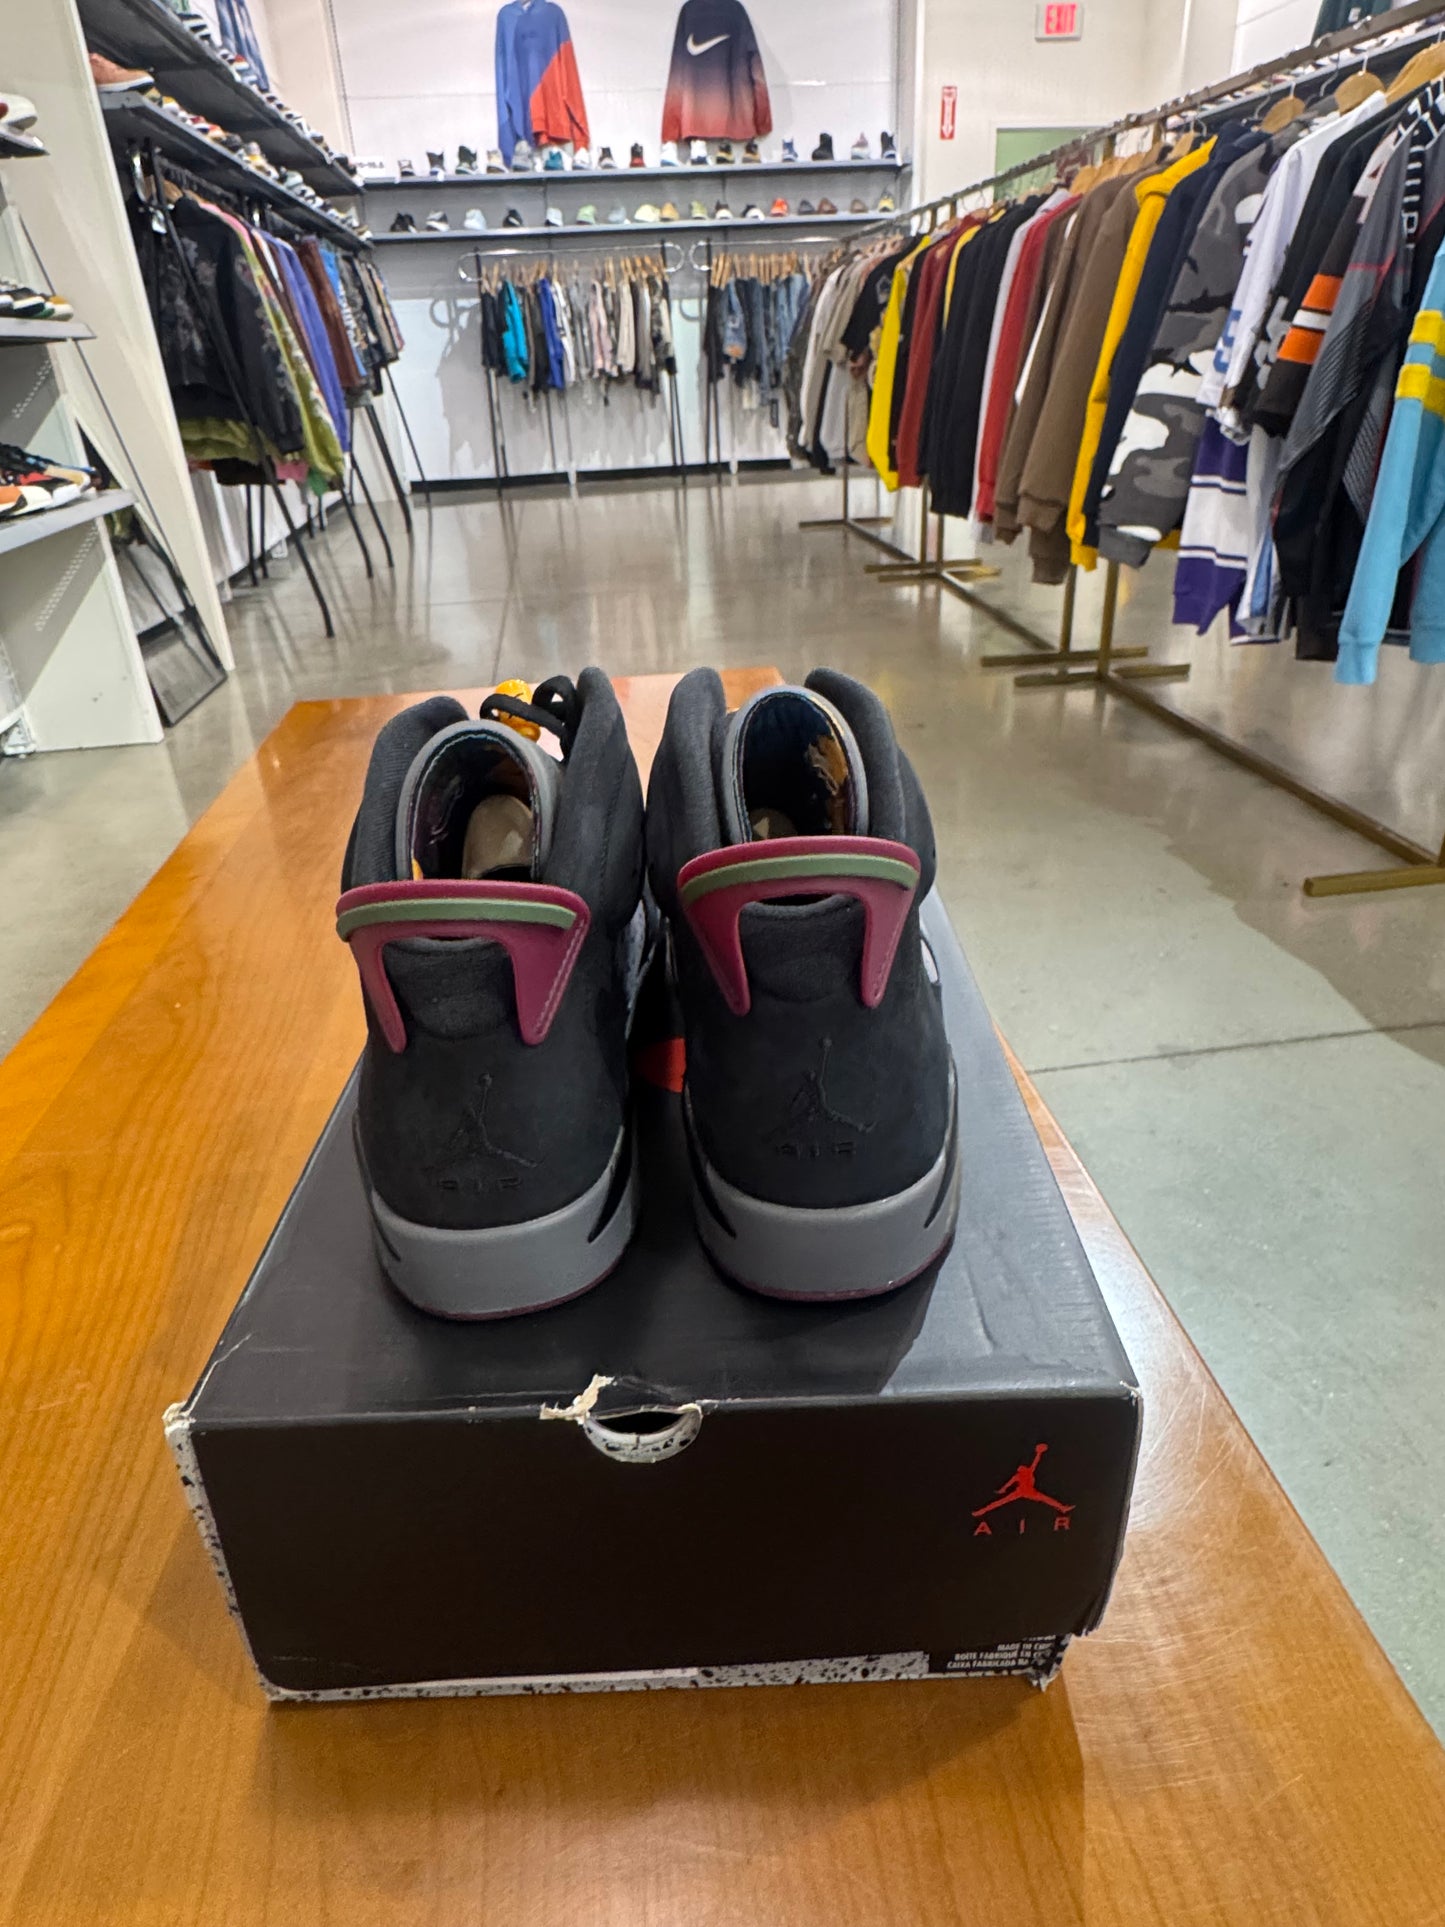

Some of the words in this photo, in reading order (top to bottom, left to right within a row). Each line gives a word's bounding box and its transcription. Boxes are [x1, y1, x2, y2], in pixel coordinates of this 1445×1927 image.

[1045, 4, 1076, 34] EXIT
[974, 1516, 1071, 1536] AIR
[997, 1642, 1021, 1652] MADE
